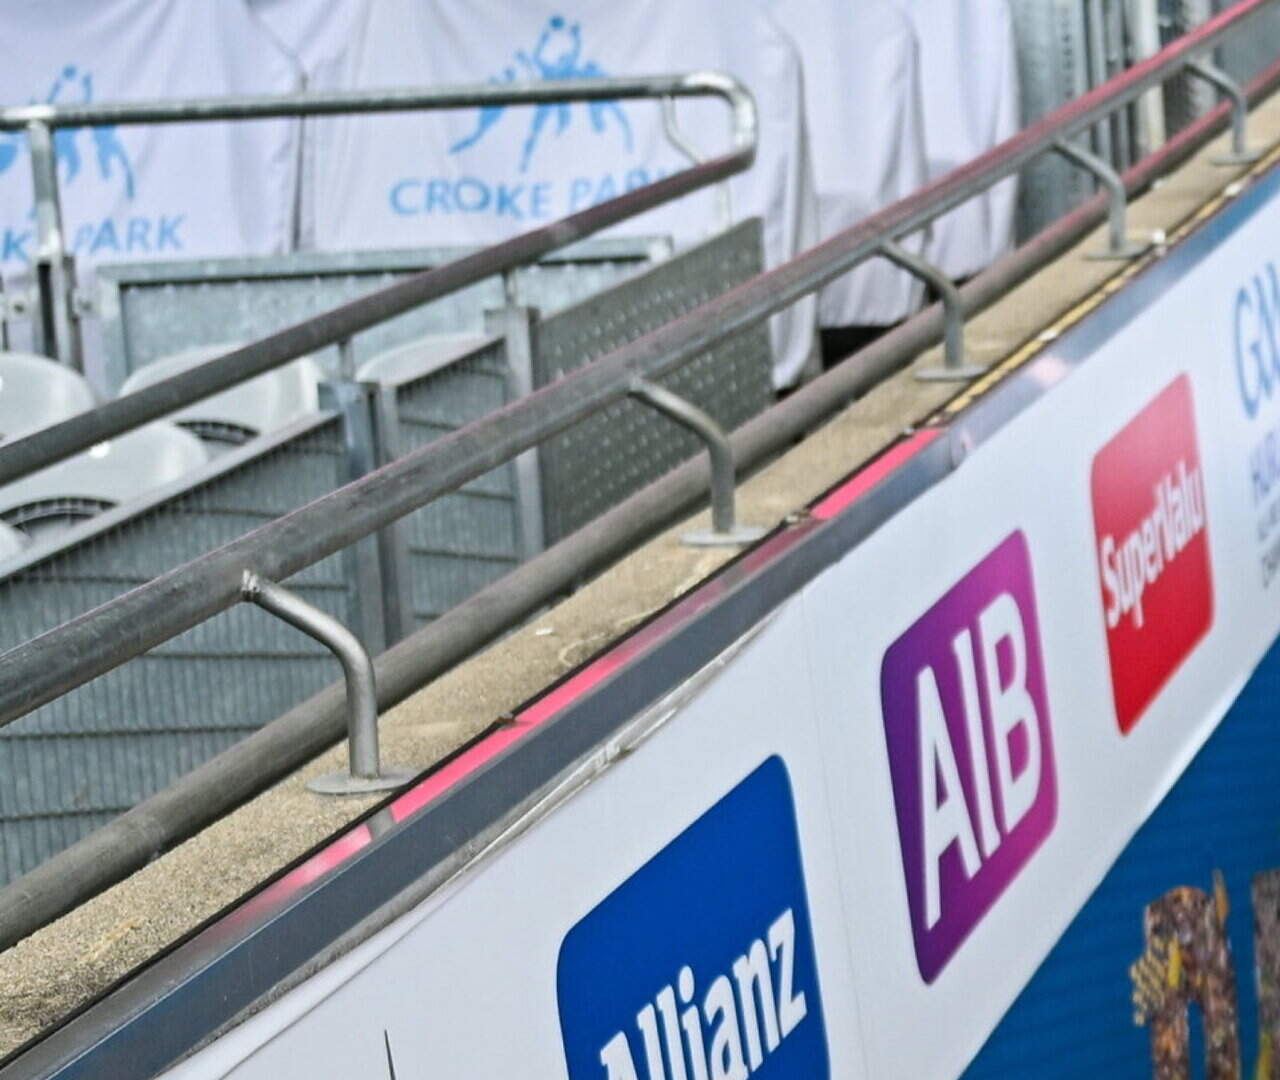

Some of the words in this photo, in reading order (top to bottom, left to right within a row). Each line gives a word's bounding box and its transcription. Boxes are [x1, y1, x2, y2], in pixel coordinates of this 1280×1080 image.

[73, 213, 187, 255] PARK
[389, 176, 550, 219] CROKE
[1101, 459, 1208, 630] SuperValu
[915, 591, 1042, 931] AIB
